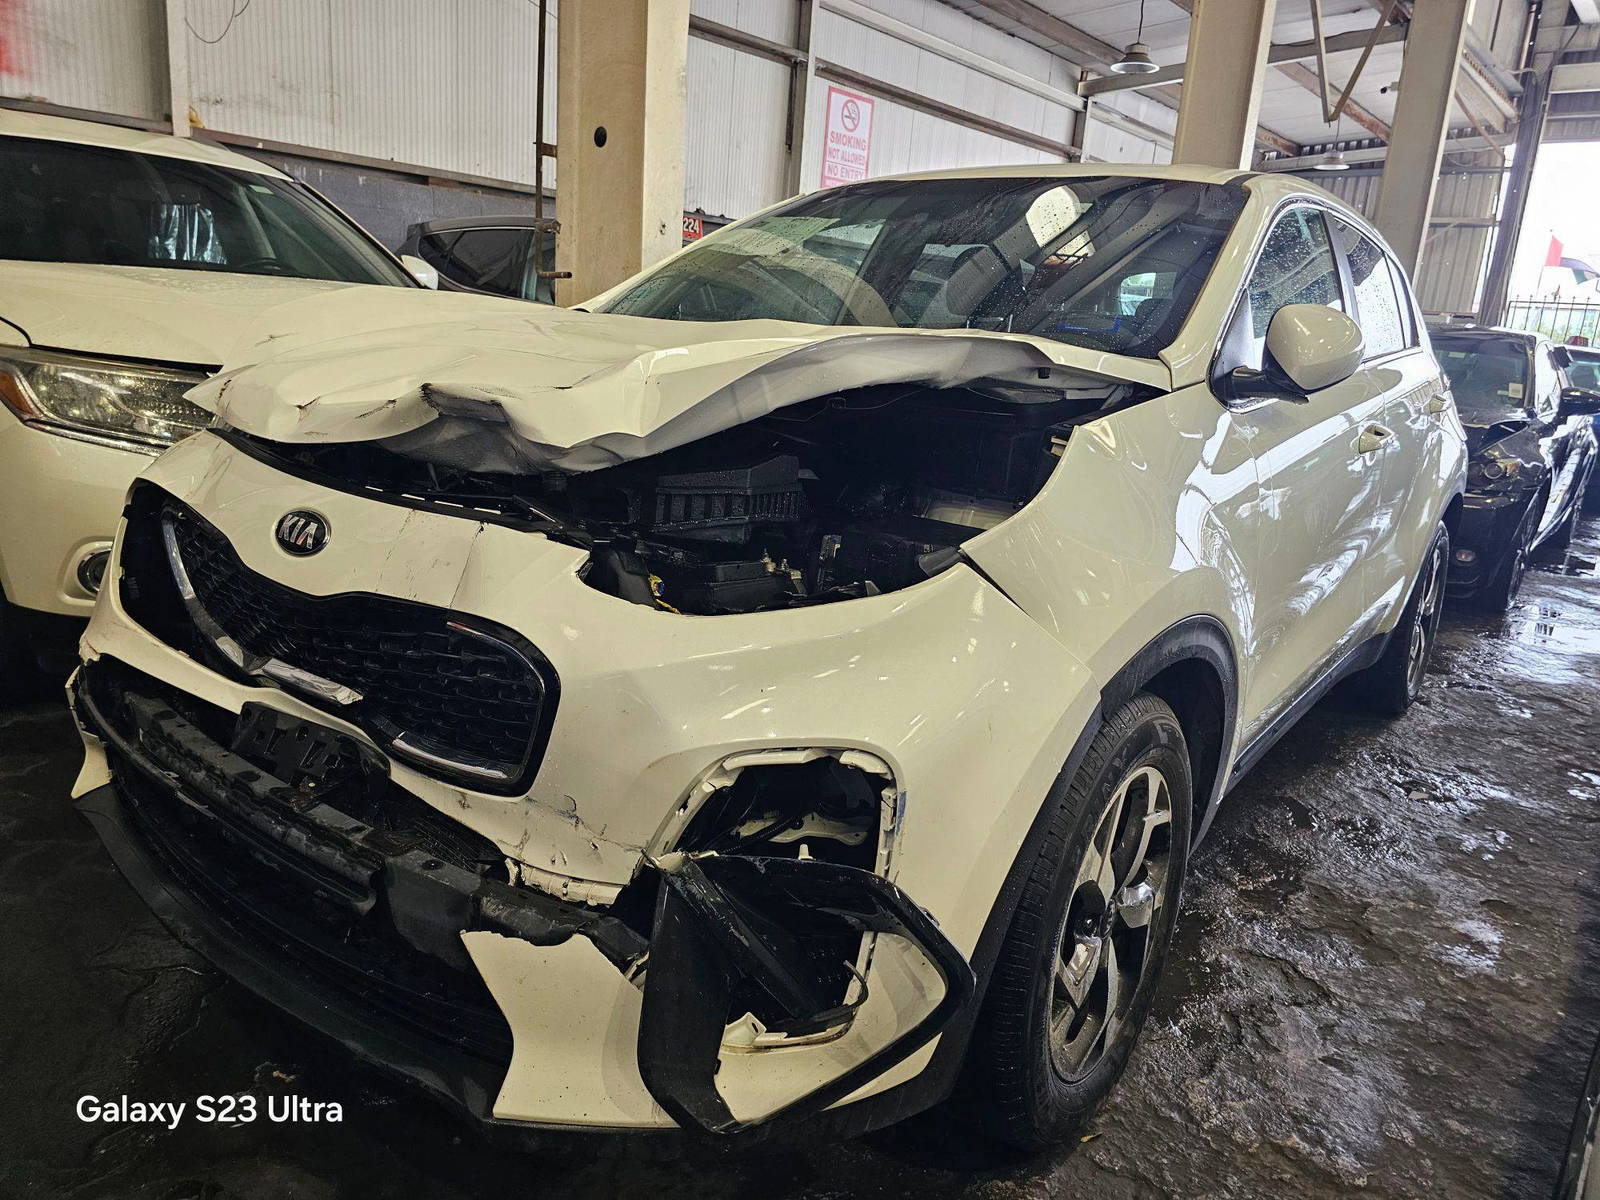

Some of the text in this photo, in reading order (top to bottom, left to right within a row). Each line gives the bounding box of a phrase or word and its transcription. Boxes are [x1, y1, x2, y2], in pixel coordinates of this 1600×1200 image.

[830, 130, 867, 151] SMOKING
[828, 147, 865, 166] NOT ALLOWED
[827, 163, 864, 180] NO ENTRY
[683, 217, 700, 234] 224
[278, 514, 318, 550] KIA
